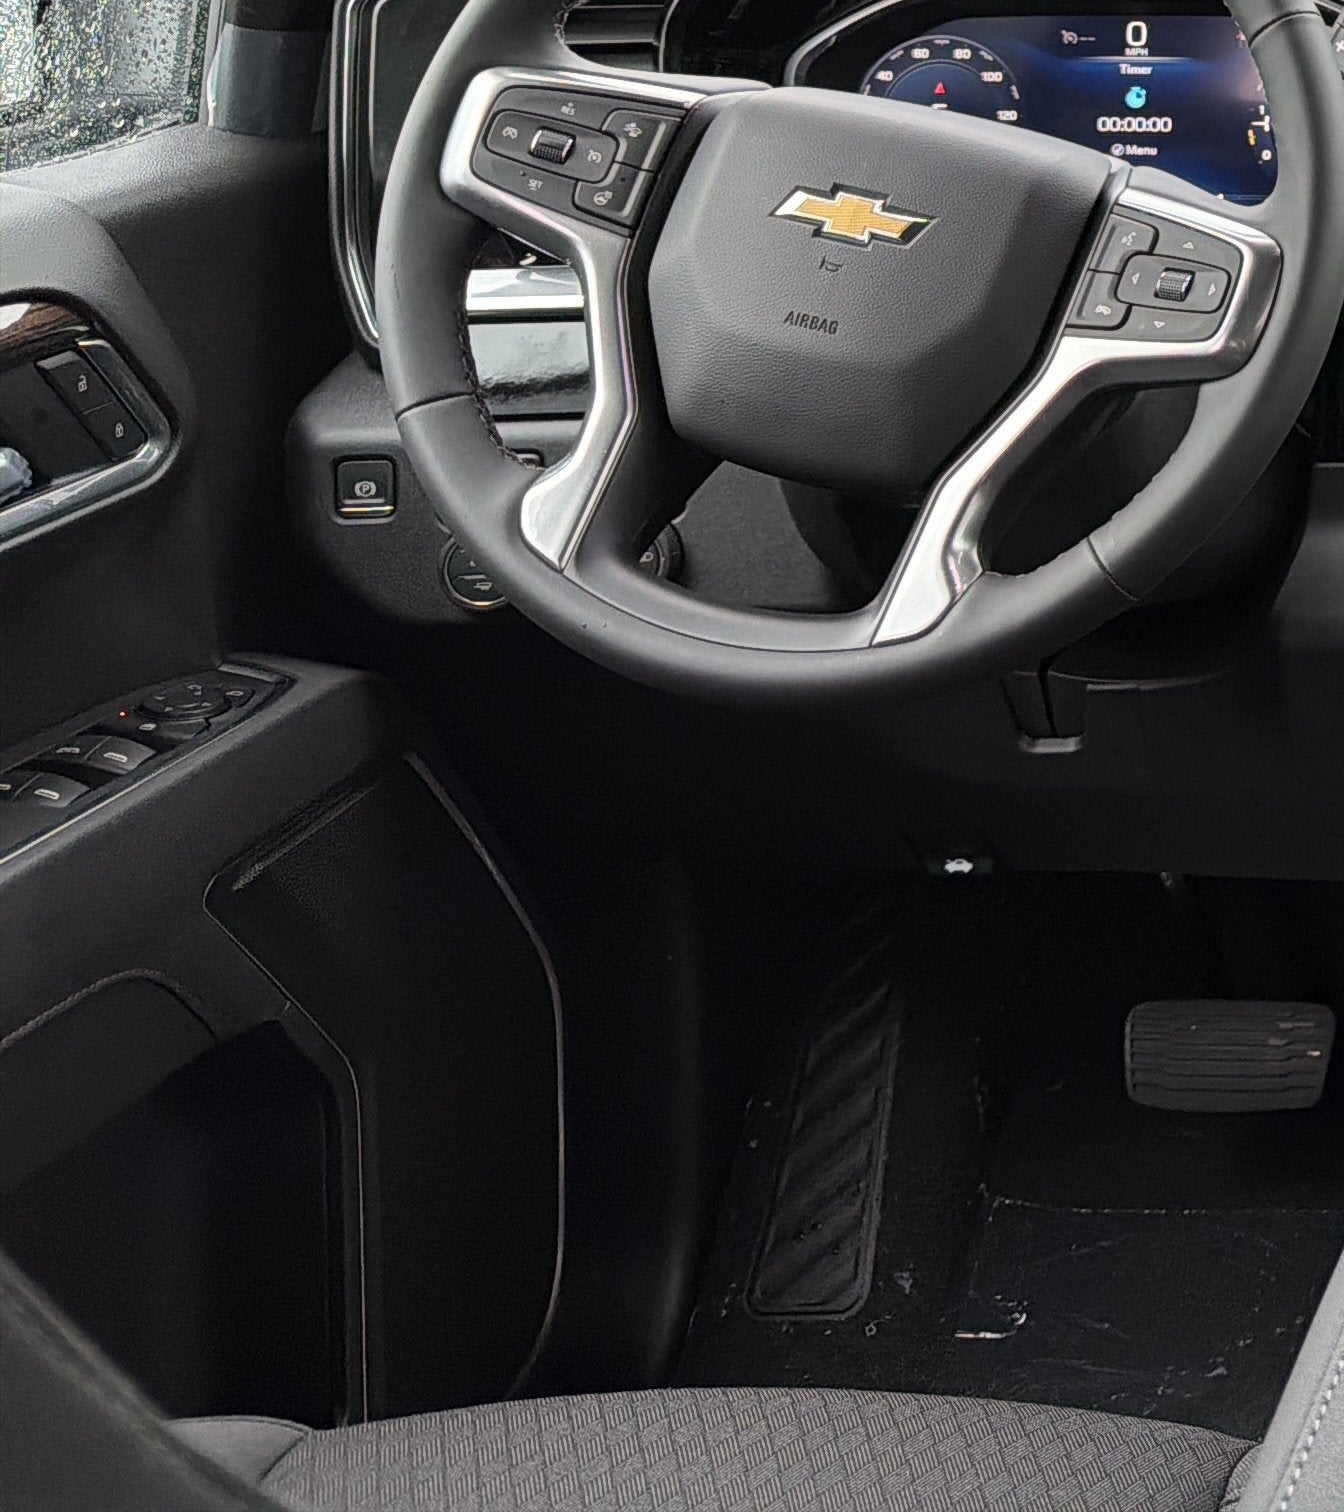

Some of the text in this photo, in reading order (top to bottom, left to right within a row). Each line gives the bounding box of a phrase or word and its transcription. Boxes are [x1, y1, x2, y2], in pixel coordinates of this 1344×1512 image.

[1126, 21, 1147, 46] 0
[911, 48, 930, 59] 60
[952, 48, 971, 59] 80
[1125, 48, 1148, 56] MPH
[1119, 64, 1153, 75] Timer
[875, 70, 893, 81] 40
[980, 71, 1003, 82] 100
[996, 110, 1018, 121] 120
[1096, 117, 1173, 133] 00:00:00
[1125, 145, 1158, 156] Menu
[783, 310, 839, 335] AIRBAG
